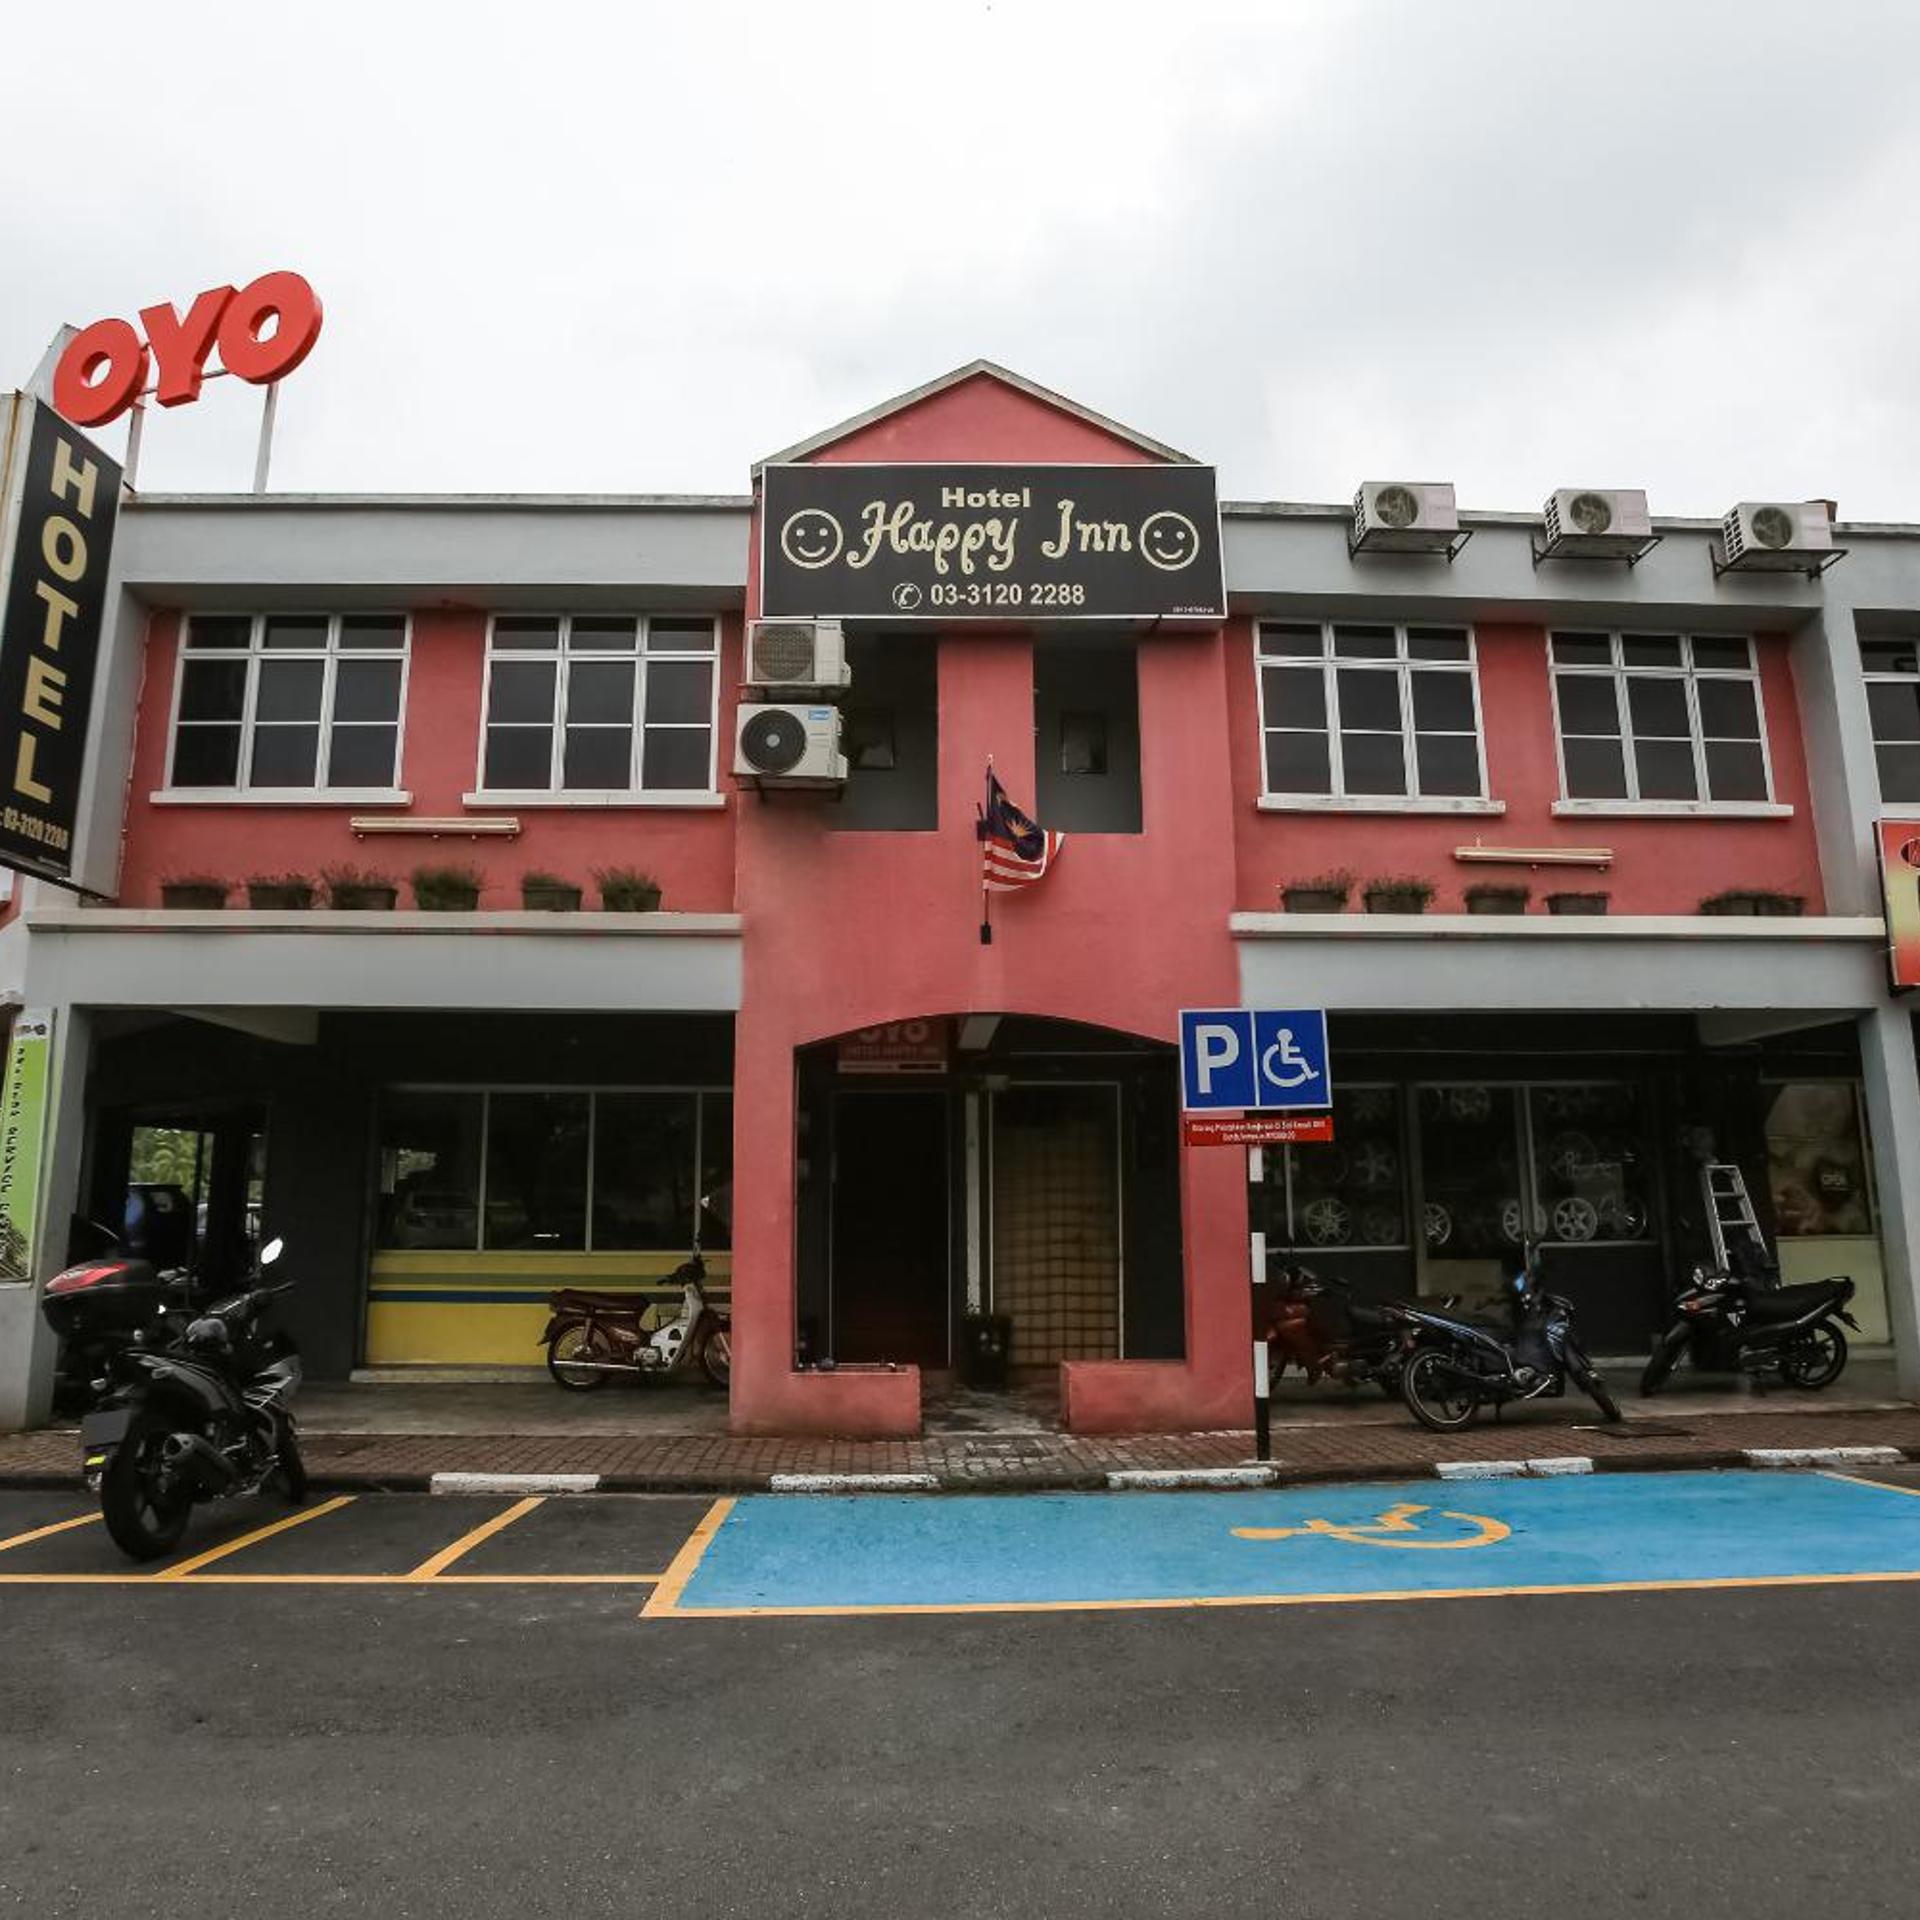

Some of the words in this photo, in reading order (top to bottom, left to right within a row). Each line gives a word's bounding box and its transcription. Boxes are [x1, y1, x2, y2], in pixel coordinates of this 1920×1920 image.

[53, 271, 323, 427] OYO
[941, 487, 1031, 508] Hotel
[846, 500, 1018, 575] Happy
[1041, 499, 1132, 559] Inn
[13, 436, 98, 804] HOTEL
[930, 583, 1022, 606] 03-3120
[1030, 583, 1086, 606] 2288
[1195, 1024, 1240, 1094] P
